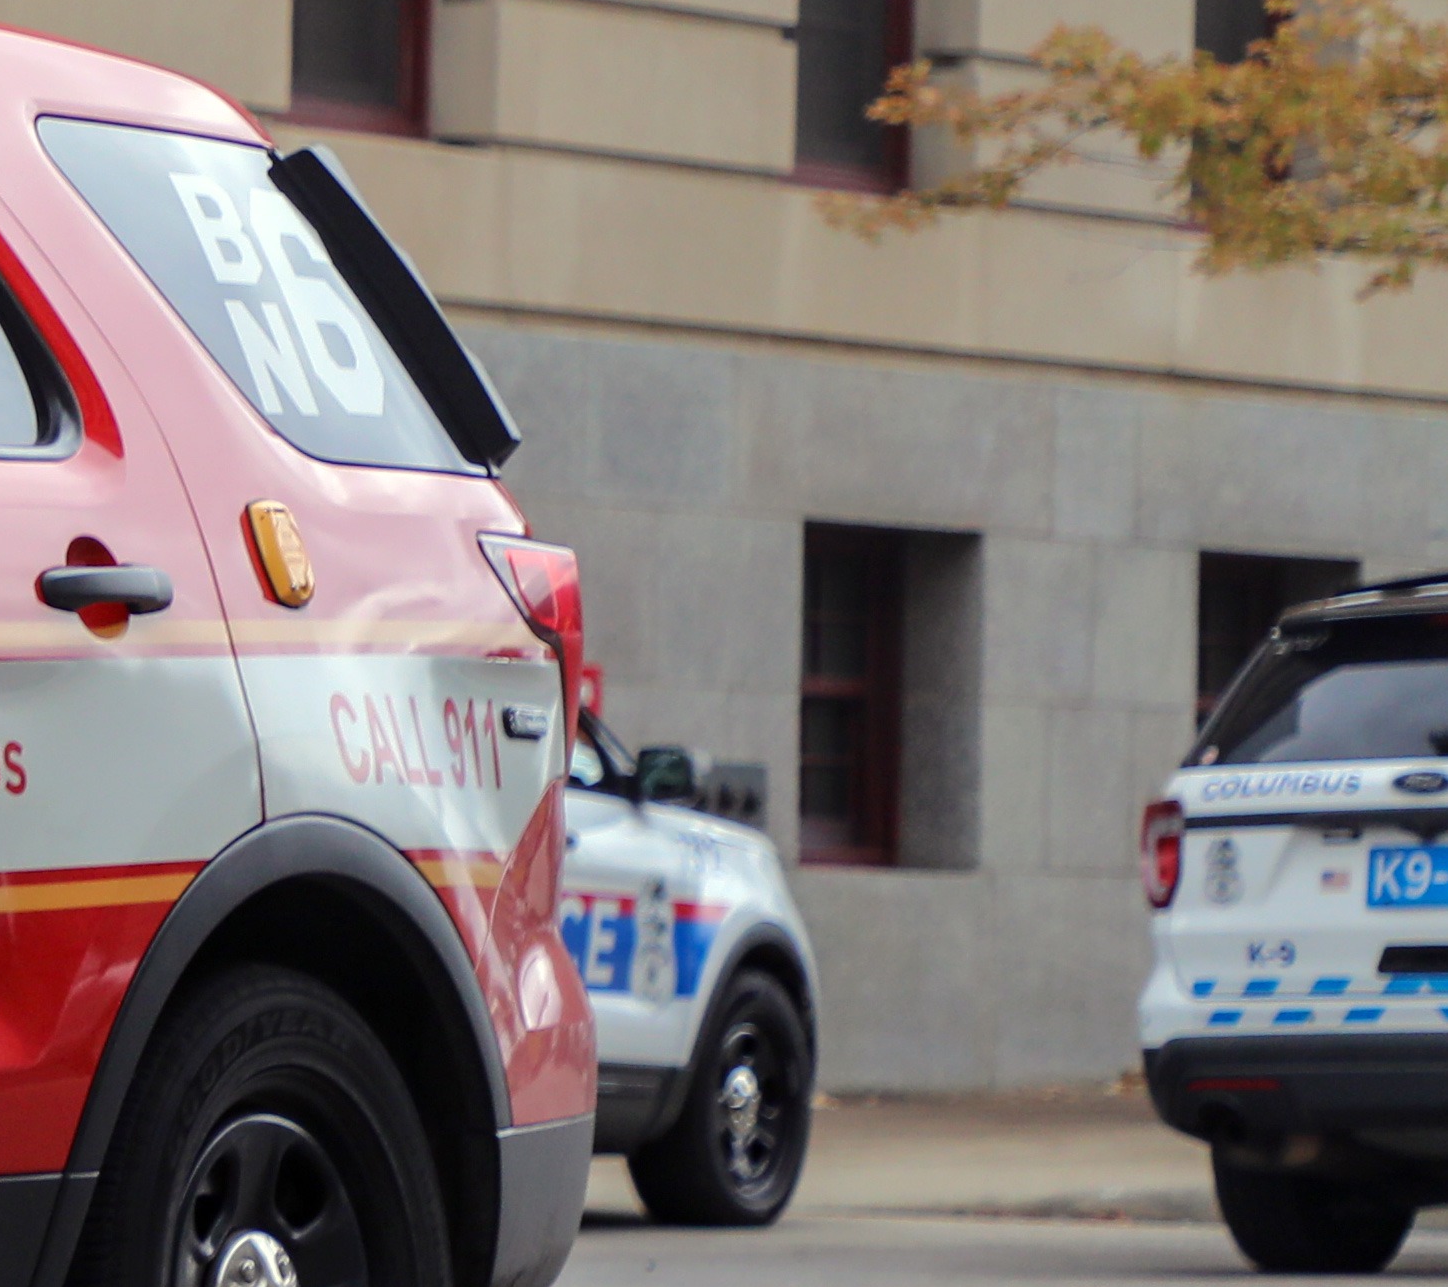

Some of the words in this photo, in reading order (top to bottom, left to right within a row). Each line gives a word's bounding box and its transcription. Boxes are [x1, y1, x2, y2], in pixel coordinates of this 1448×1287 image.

[250, 188, 384, 417] 6
[329, 693, 444, 787] CALL
[444, 696, 502, 790] 911
[1203, 772, 1361, 801] COLUMBUS
[1246, 938, 1297, 968] K-9
